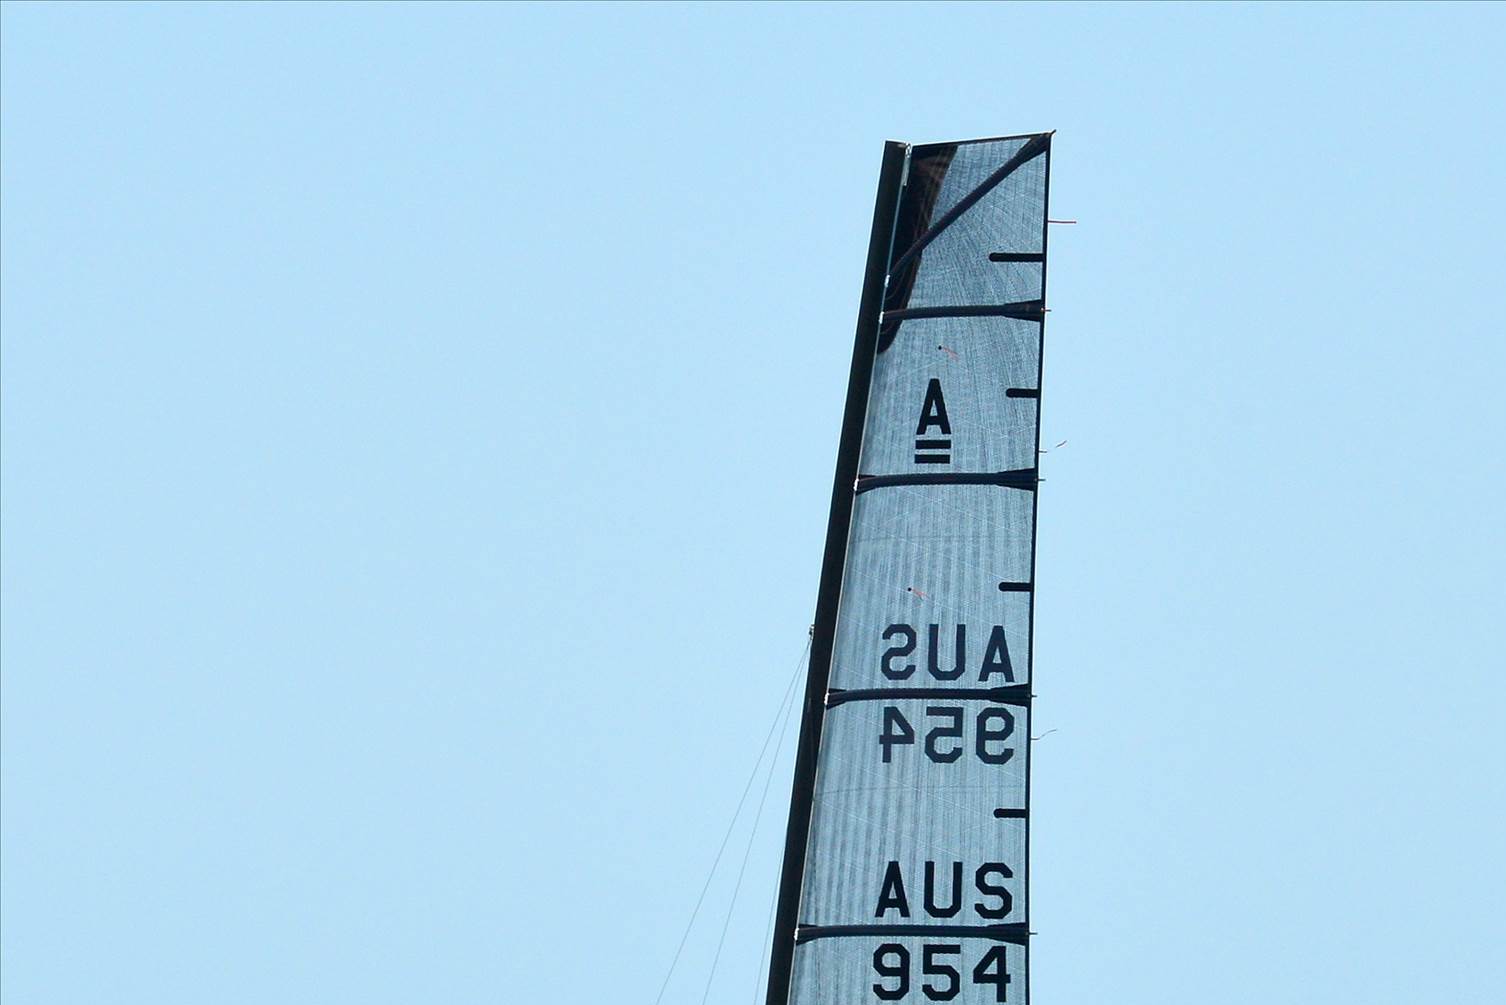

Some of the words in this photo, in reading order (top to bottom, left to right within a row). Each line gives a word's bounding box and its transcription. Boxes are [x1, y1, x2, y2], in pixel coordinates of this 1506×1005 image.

[916, 378, 952, 436] A
[874, 860, 1014, 920] AUS
[872, 943, 1012, 1003] 954
